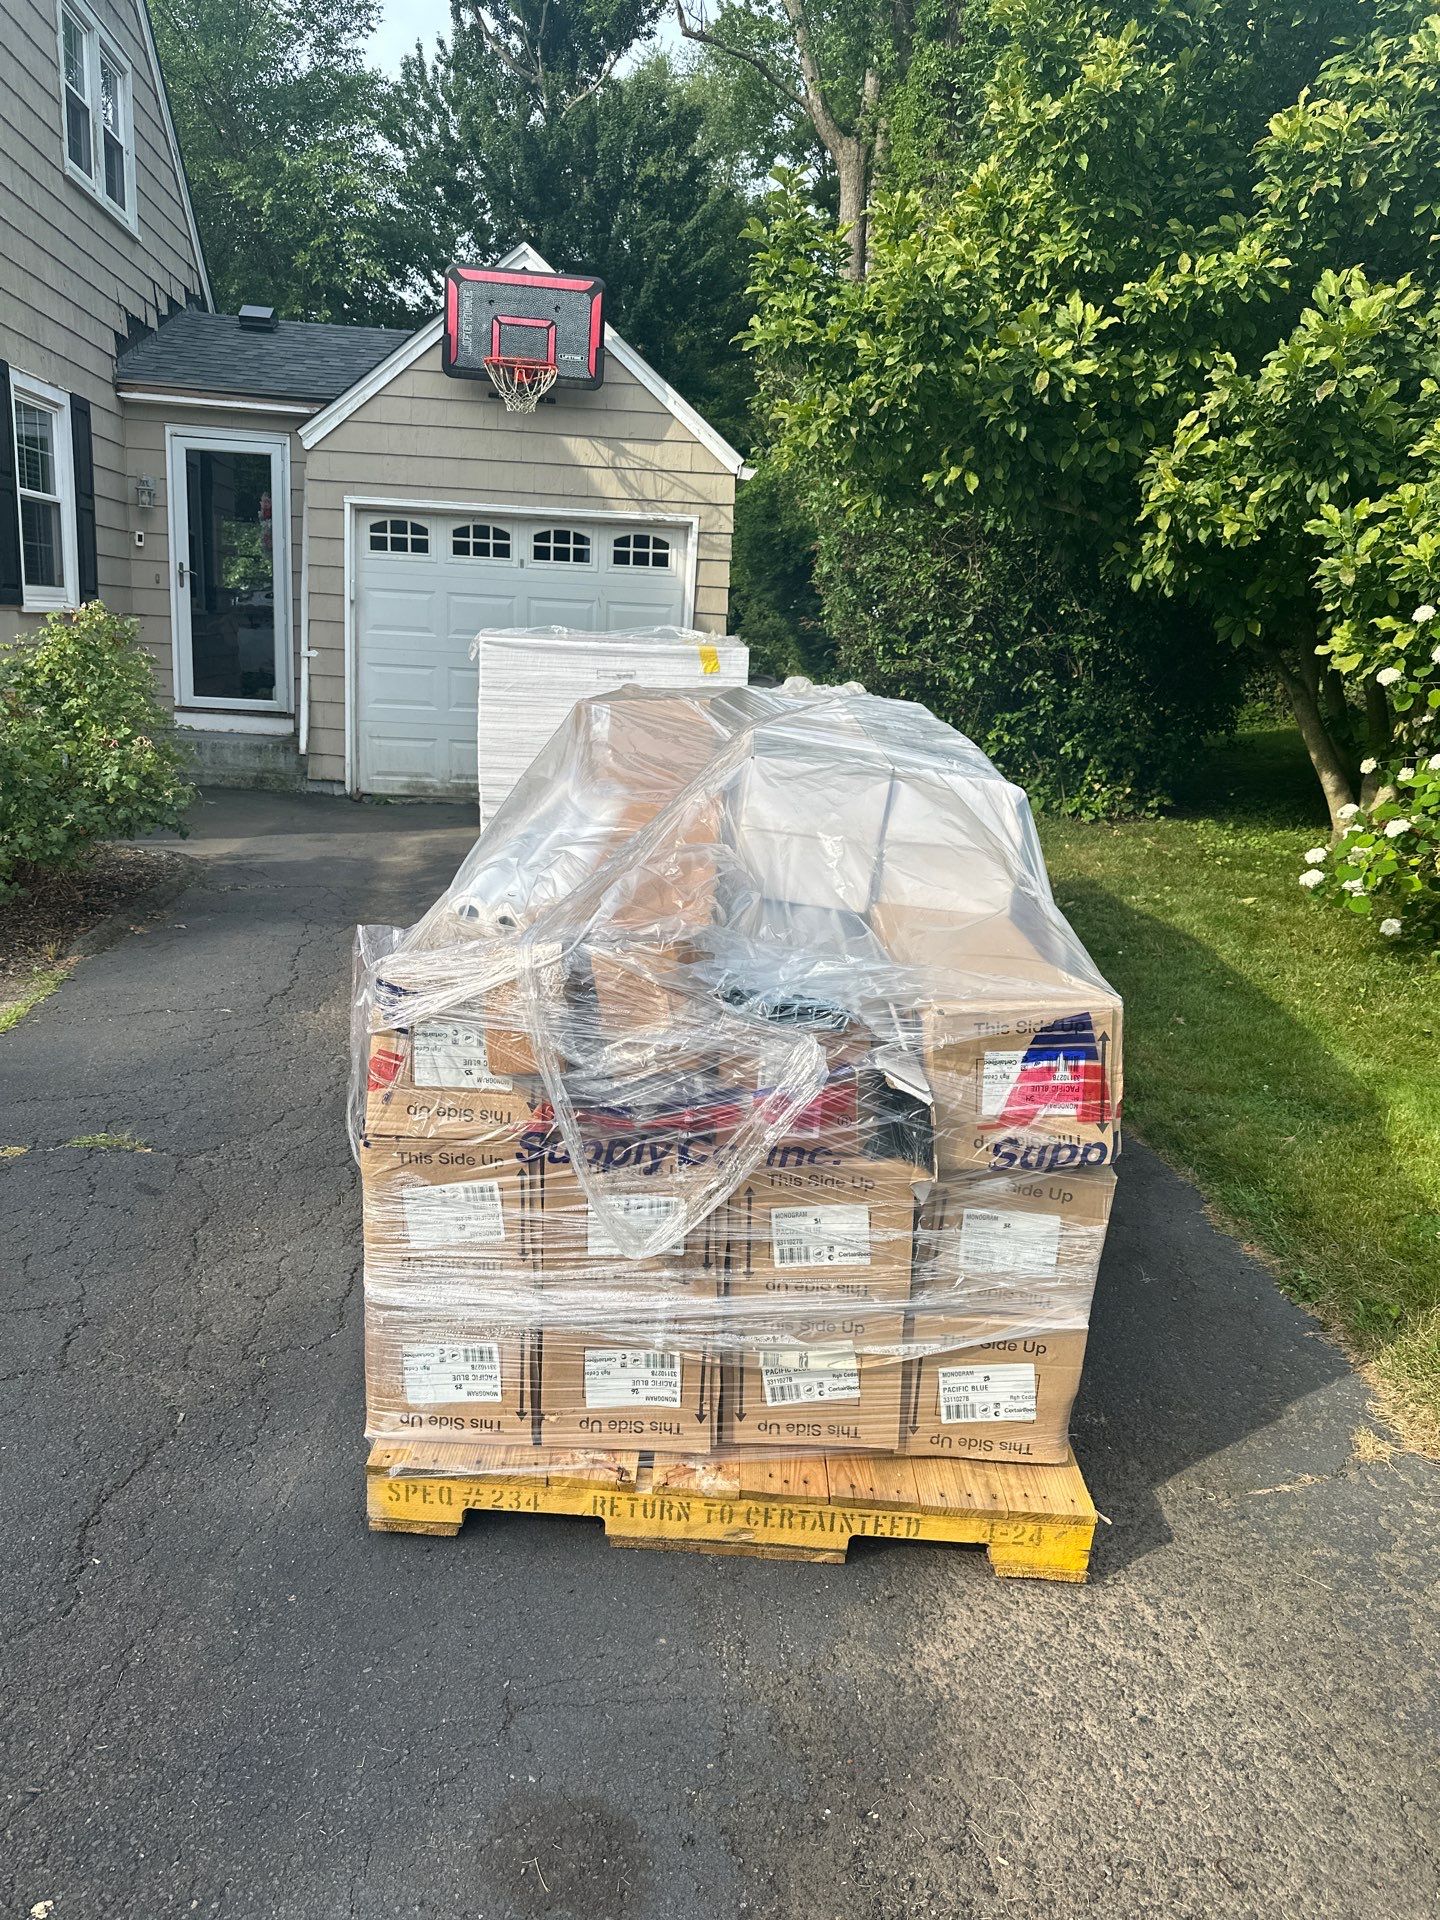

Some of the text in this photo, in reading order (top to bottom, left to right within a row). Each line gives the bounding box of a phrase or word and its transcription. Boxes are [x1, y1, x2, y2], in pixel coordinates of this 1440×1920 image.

[462, 289, 473, 356] LIFETIME
[974, 1022, 1010, 1035] This
[1016, 1020, 1054, 1035] Sid
[437, 1106, 474, 1123] Side
[480, 1108, 511, 1124] This
[397, 1151, 504, 1169] This Side Up
[516, 1132, 674, 1175] Supply
[768, 1174, 875, 1191] This Side Up
[1049, 1187, 1073, 1204] Up
[775, 1211, 807, 1219] MONOGRAM
[966, 1213, 998, 1221] MONOGRAM
[800, 1320, 836, 1333] Side
[842, 1320, 865, 1336] Up
[980, 1339, 1017, 1352] Side
[1023, 1340, 1047, 1356] Up
[942, 1370, 975, 1378] MONOGRAM
[943, 1384, 989, 1393] PACIFIC BLUE
[400, 1412, 504, 1433] This Side Up
[579, 1417, 684, 1435] This Side Up
[758, 1420, 861, 1439] This Side Up
[930, 1434, 1033, 1455] This Side Up
[592, 1495, 691, 1522] RETURN
[704, 1502, 734, 1525] TO
[746, 1506, 921, 1537] CERTAINTEED
